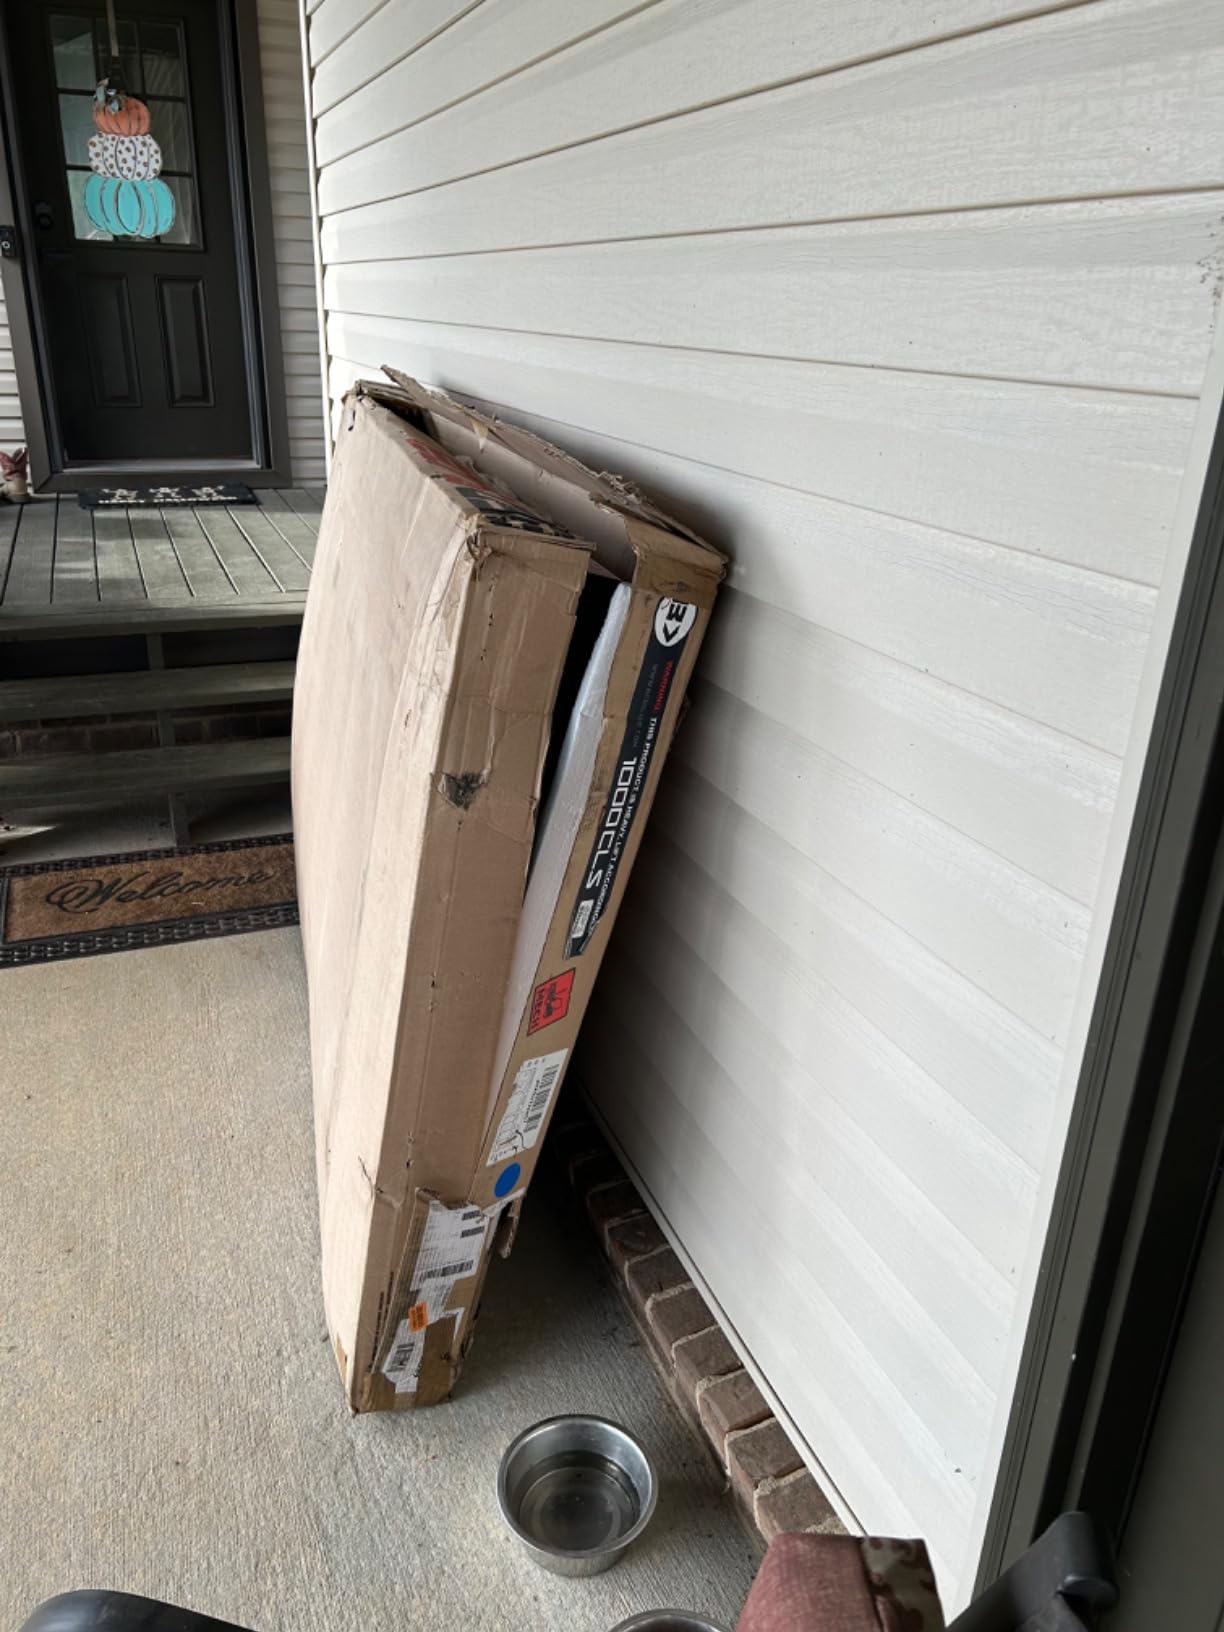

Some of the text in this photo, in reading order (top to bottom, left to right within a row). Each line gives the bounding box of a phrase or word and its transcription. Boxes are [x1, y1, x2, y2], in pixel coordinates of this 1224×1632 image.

[646, 717, 657, 740] THIS
[634, 742, 651, 791] PRODUCT
[46, 870, 277, 914] Welcome
